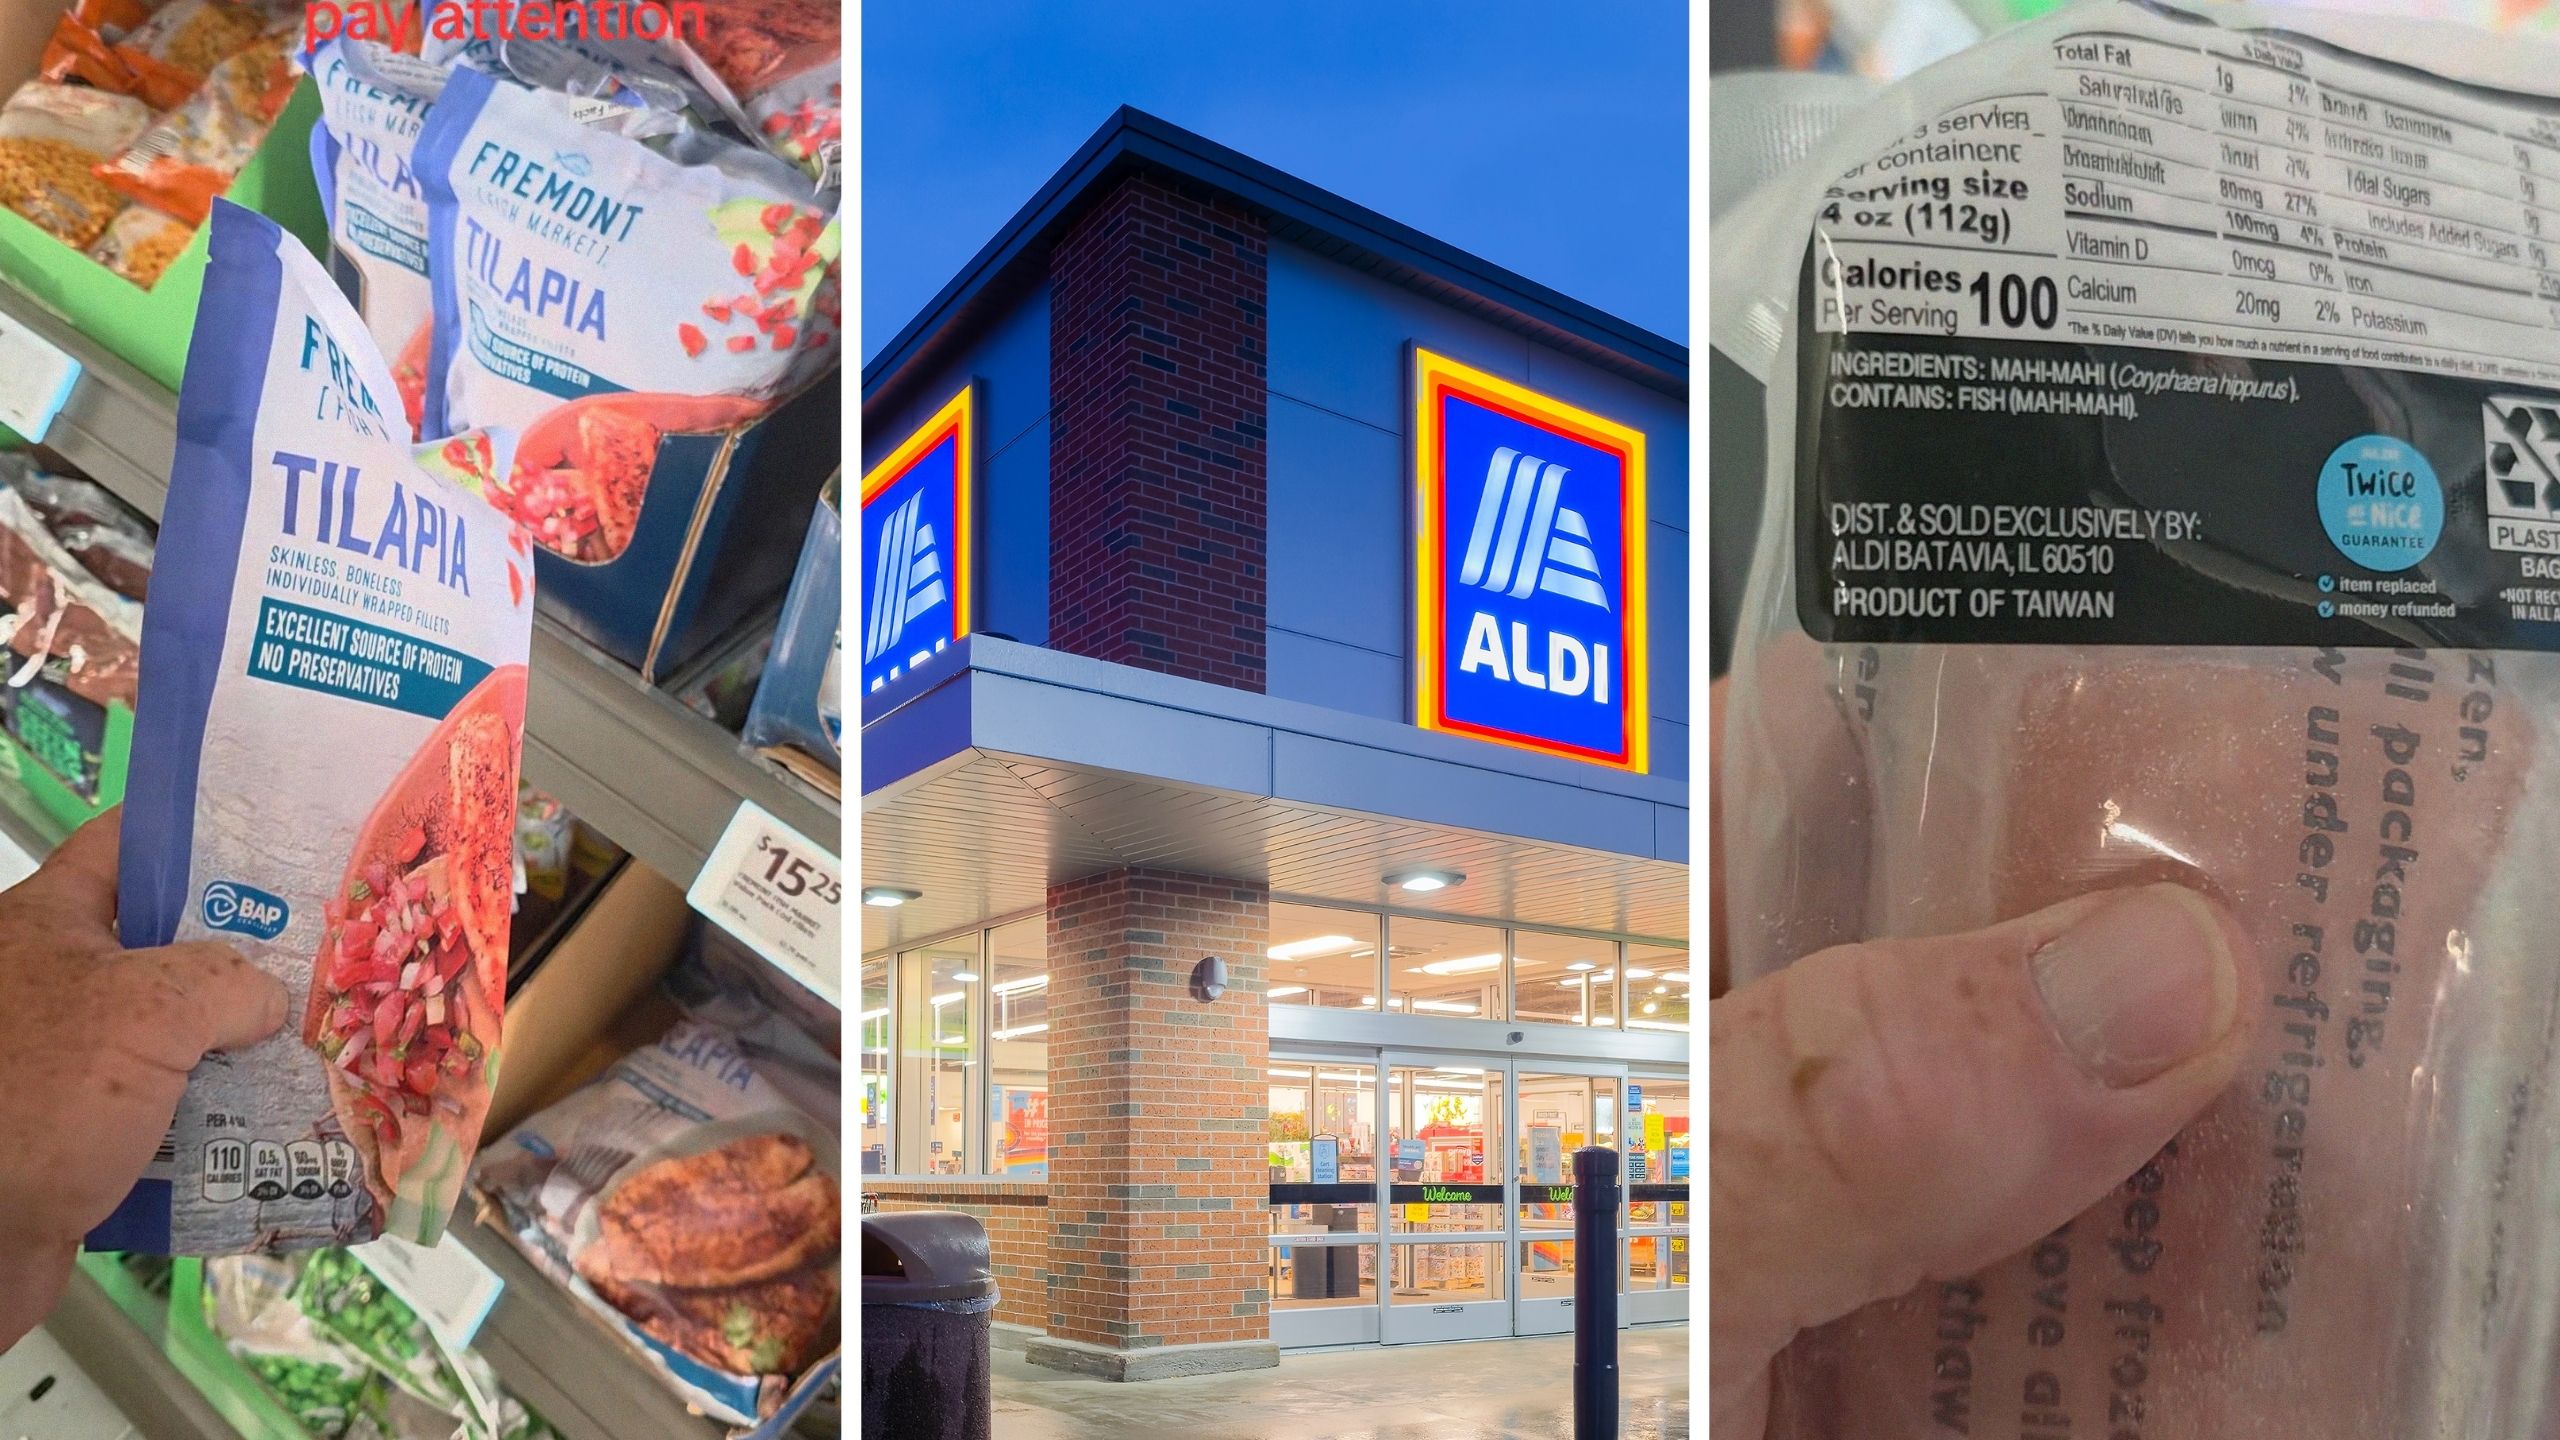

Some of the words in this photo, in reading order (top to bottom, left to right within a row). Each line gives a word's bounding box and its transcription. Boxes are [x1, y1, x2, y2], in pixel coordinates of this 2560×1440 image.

[2054, 44, 2098, 62] Total
[2105, 46, 2132, 67] Fat
[2216, 65, 2233, 94] 1g
[469, 141, 644, 243] FREMONT
[1963, 169, 2030, 200] size
[2220, 178, 2264, 209] 80mg
[2383, 178, 2431, 207] Sugars
[1821, 202, 1842, 224] 4
[1853, 211, 1893, 227] oz
[1904, 202, 2011, 245] (112g)
[2065, 177, 2134, 212] Sodium
[2227, 210, 2280, 241] 100mg
[2066, 229, 2130, 260] Vitamin
[2135, 238, 2149, 260] D
[2232, 249, 2277, 280] 0mcg
[466, 216, 606, 342] TILAPIA
[1822, 257, 1963, 293] Calories
[1970, 271, 2059, 331] 100
[2344, 271, 2373, 292] Iron
[2067, 275, 2137, 304] Calcium
[2236, 290, 2280, 322] 20mg
[2315, 300, 2341, 324] 2%
[1823, 298, 1863, 325] Per
[1870, 298, 1958, 336] Serving
[2103, 324, 2126, 340] Daily
[2128, 326, 2154, 340] Value
[2352, 306, 2428, 336] Potassium
[1830, 352, 1986, 381] INGREDIENTS:
[1991, 358, 2105, 386] MAHI-MAHI
[1830, 382, 1954, 410] CONTAINS:
[1958, 387, 2006, 412] FISH
[2340, 463, 2416, 498] Twice
[272, 451, 471, 598] TILAPIA
[1832, 503, 1895, 536] DIST.
[1897, 503, 1917, 535] &
[1918, 504, 1991, 537] SOLD
[1994, 505, 2161, 540] EXCLUSIVELY
[2164, 510, 2202, 541] BY:
[1832, 540, 1890, 572] ALDI
[1895, 540, 2015, 577] BATAVIA,
[2018, 542, 2039, 573] IL
[2042, 544, 2115, 575] 60510
[2342, 534, 2425, 549] GUARANTEE
[346, 565, 404, 597] BONELESS
[2339, 576, 2373, 593] item
[2375, 578, 2437, 595] replaced
[265, 568, 359, 607] INDIVIDUALLY
[363, 593, 413, 624] WRAPPED
[415, 609, 450, 636] FILLETS
[1833, 587, 1962, 618] PRODUCT
[1969, 588, 2006, 618] OF
[2011, 589, 2115, 619] TAIWAN
[2338, 602, 2390, 618] money
[2391, 601, 2456, 618] refunded
[2512, 605, 2527, 620] IN
[2529, 605, 2551, 621] ALL
[265, 606, 350, 653] EXCELLENT
[350, 627, 403, 667] SOURCE
[402, 642, 419, 671] OF
[418, 645, 463, 685] PROTEIN
[1460, 611, 1609, 705] ALDI
[257, 641, 285, 673] NO
[288, 649, 401, 701] PRESERVATIVES
[2296, 705, 2349, 904] under
[239, 897, 282, 926] BAP
[206, 1113, 227, 1128] PER
[211, 1146, 241, 1170] 110
[269, 1167, 284, 1178] FAT
[1423, 1186, 1472, 1202] Welcome
